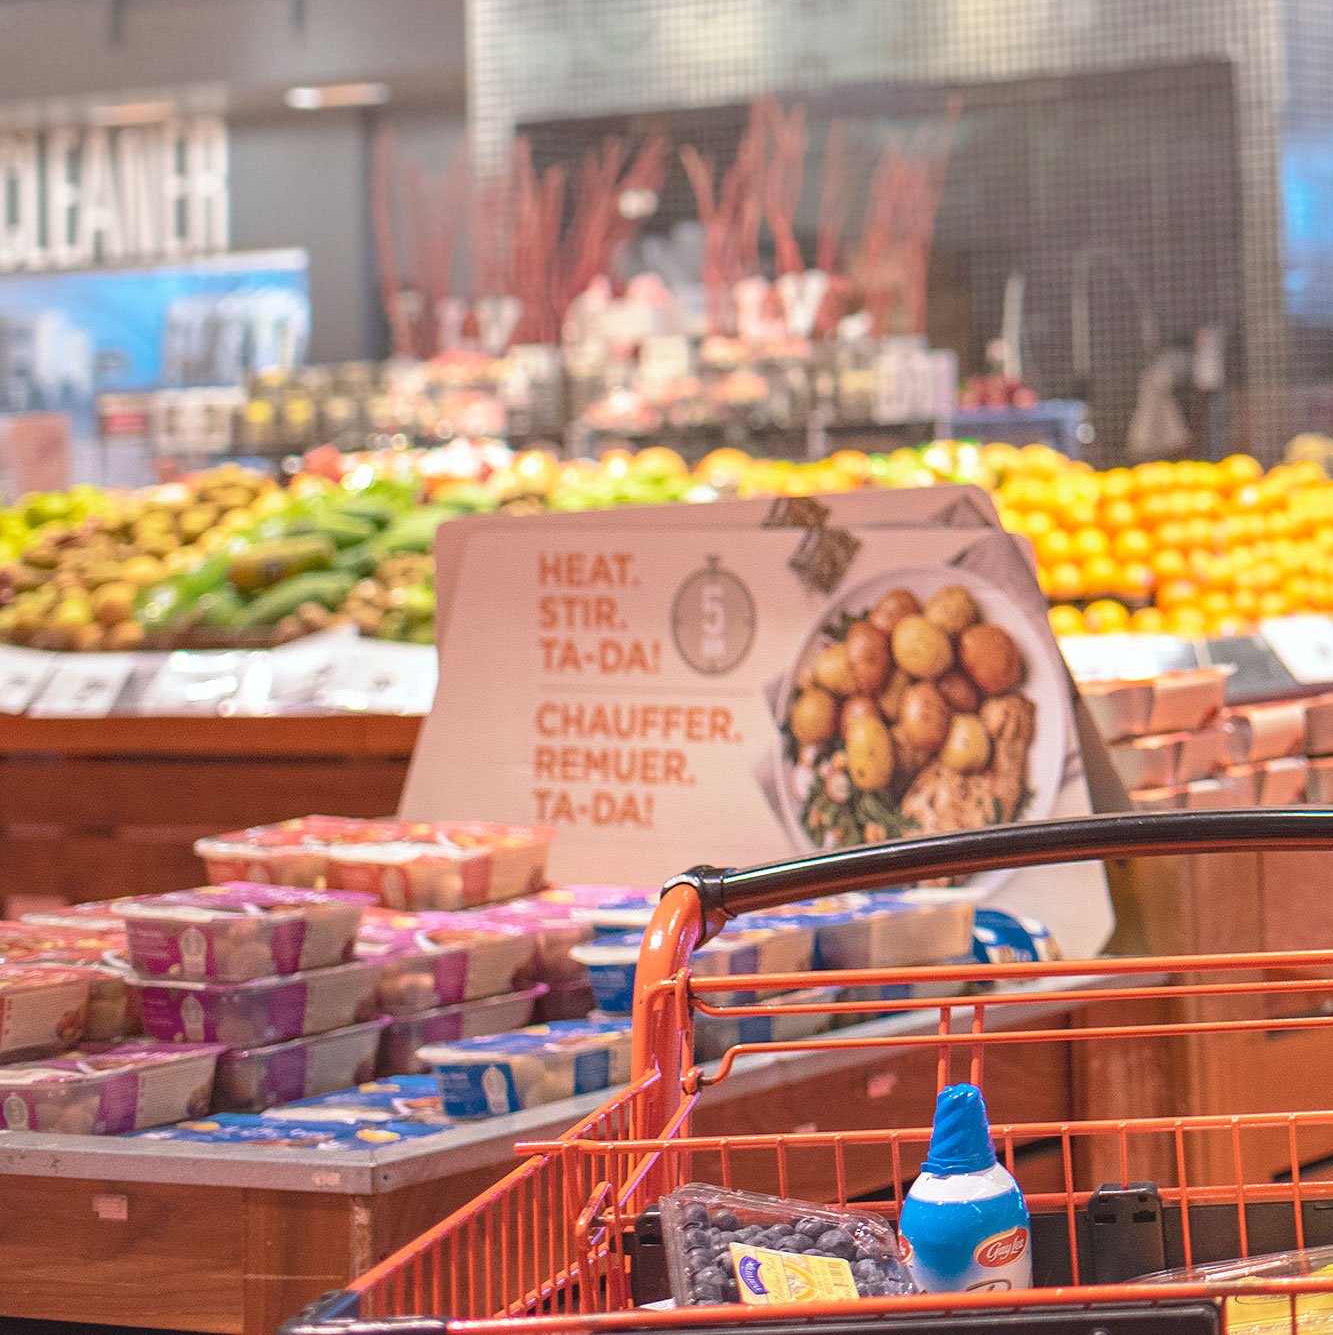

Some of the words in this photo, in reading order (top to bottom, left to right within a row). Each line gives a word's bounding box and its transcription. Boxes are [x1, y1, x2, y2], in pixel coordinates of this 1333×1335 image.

[538, 552, 641, 587] HEAT.
[539, 596, 629, 631] STIR.
[702, 584, 726, 635] 5
[539, 638, 662, 675] TA-DA!
[535, 701, 743, 744] CHAUFFER.
[534, 744, 698, 787] REMUER.
[532, 788, 655, 829] TA-DA!
